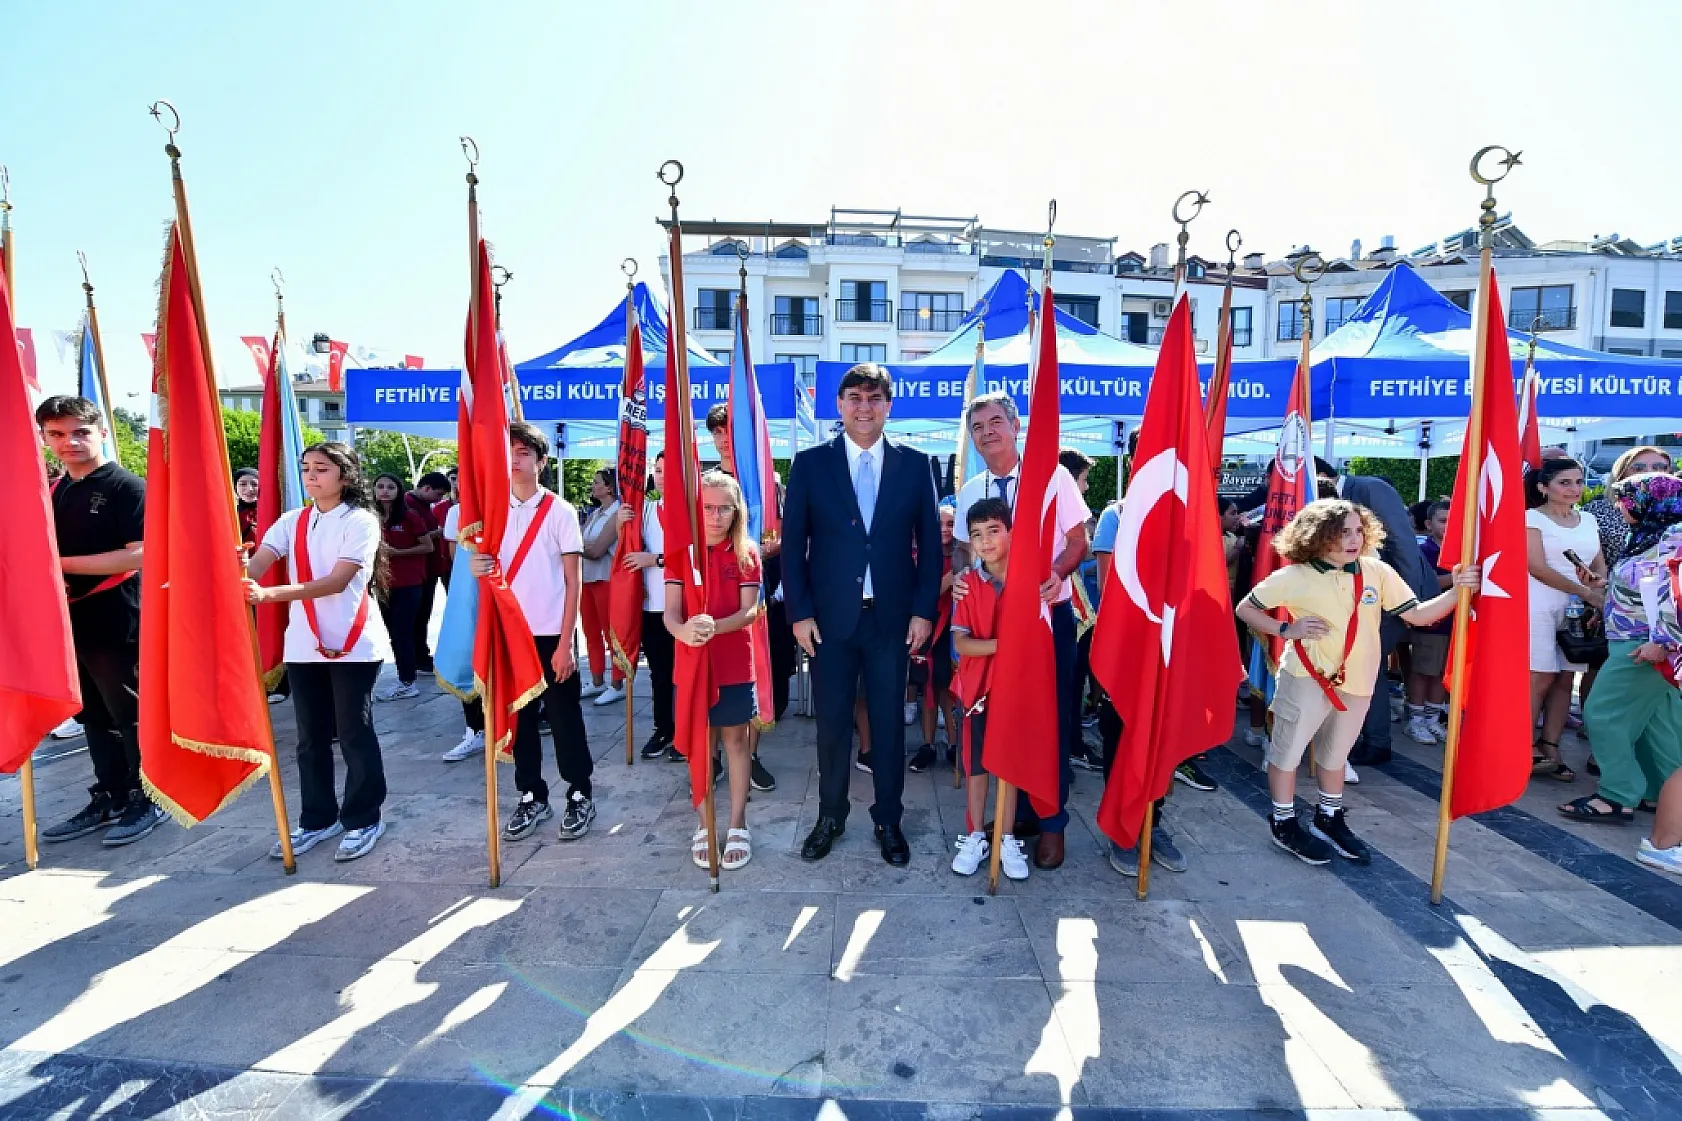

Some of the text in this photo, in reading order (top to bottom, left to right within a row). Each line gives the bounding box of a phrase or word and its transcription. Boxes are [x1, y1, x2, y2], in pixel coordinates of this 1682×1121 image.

[375, 384, 450, 402] FETHİYE
[1060, 376, 1142, 397] KÜLTÜR
[1370, 375, 1458, 397] FETHİYE
[1590, 374, 1672, 396] KÜLTÜR
